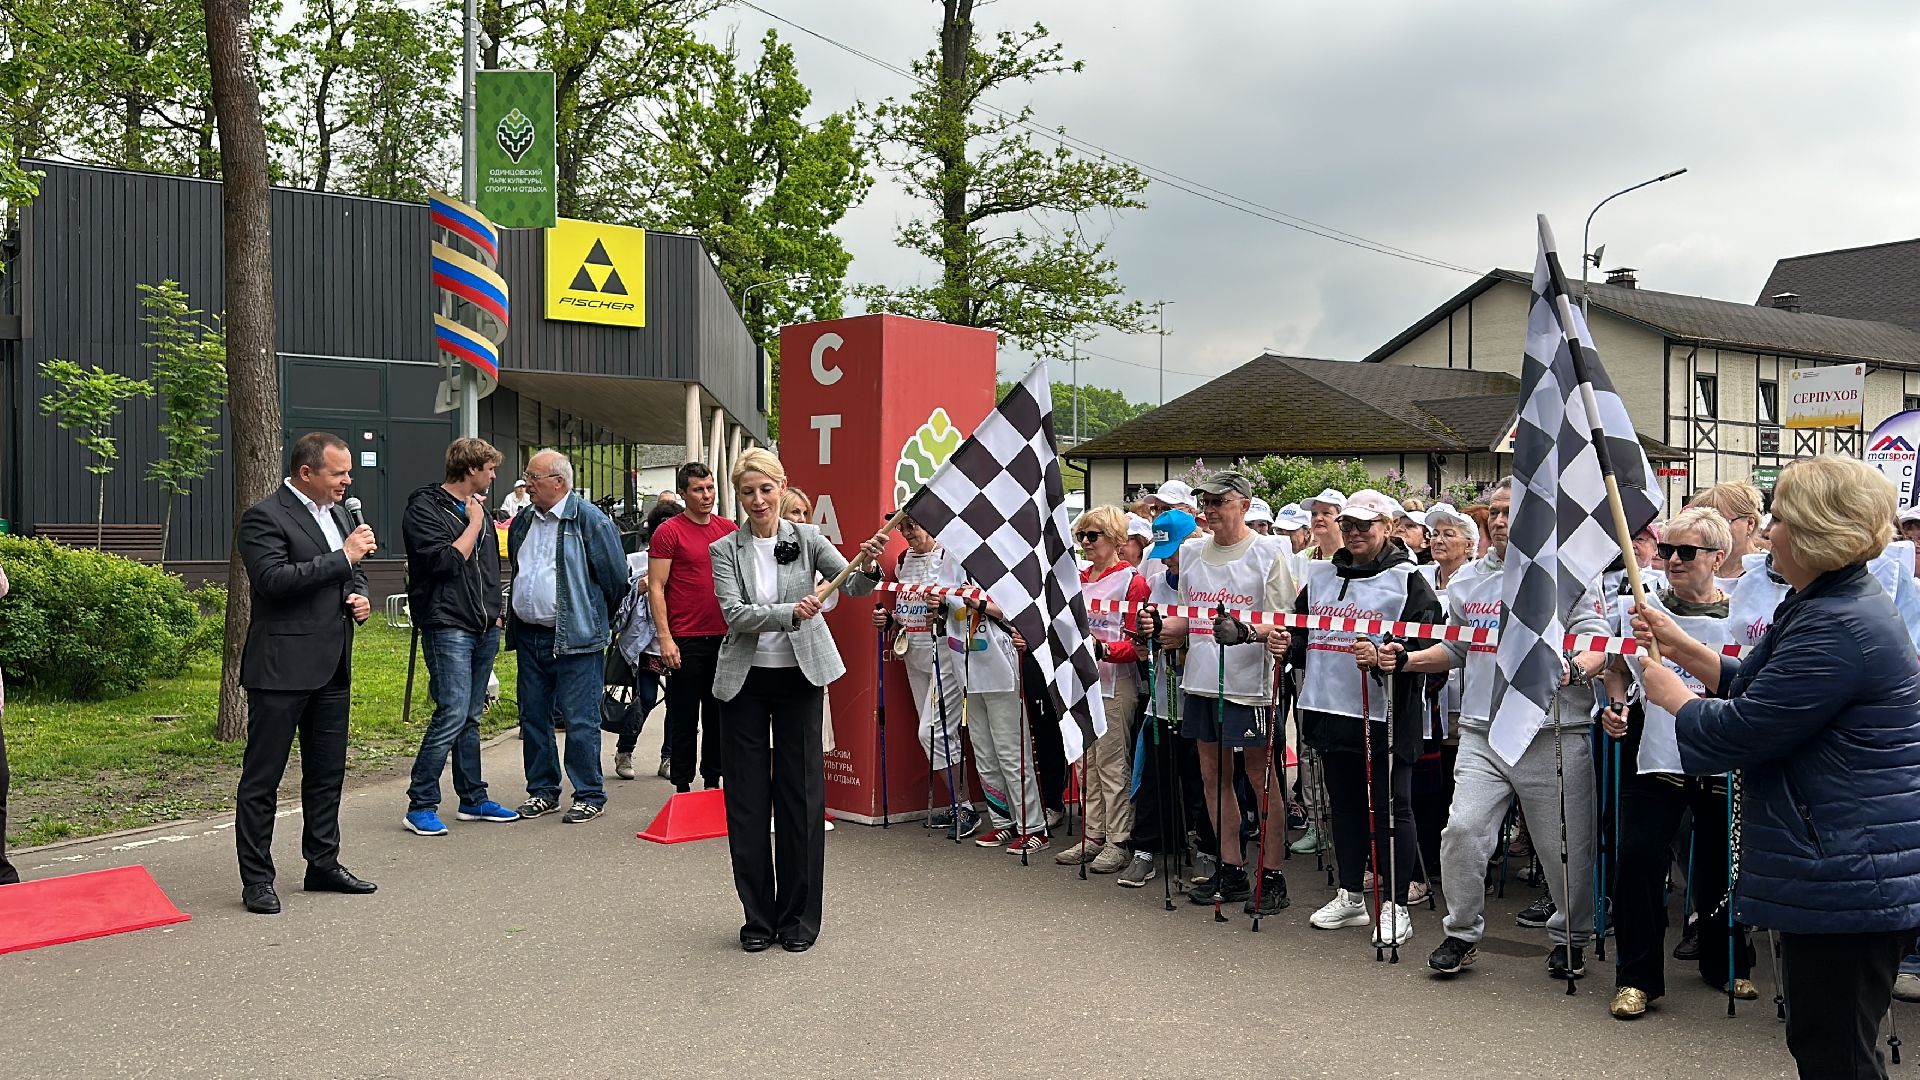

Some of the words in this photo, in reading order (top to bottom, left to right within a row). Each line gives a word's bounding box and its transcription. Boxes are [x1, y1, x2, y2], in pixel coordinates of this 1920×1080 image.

[489, 168, 543, 176] ОДИНЦОВСКИЙ
[485, 185, 512, 193] СПОРТА
[519, 186, 548, 194] ОТДЫХА
[559, 297, 635, 311] FISCHER
[1793, 389, 1858, 405] СЕРПУХОВ
[1868, 452, 1916, 461] marsport
[833, 774, 860, 786] ОТДЫХА
